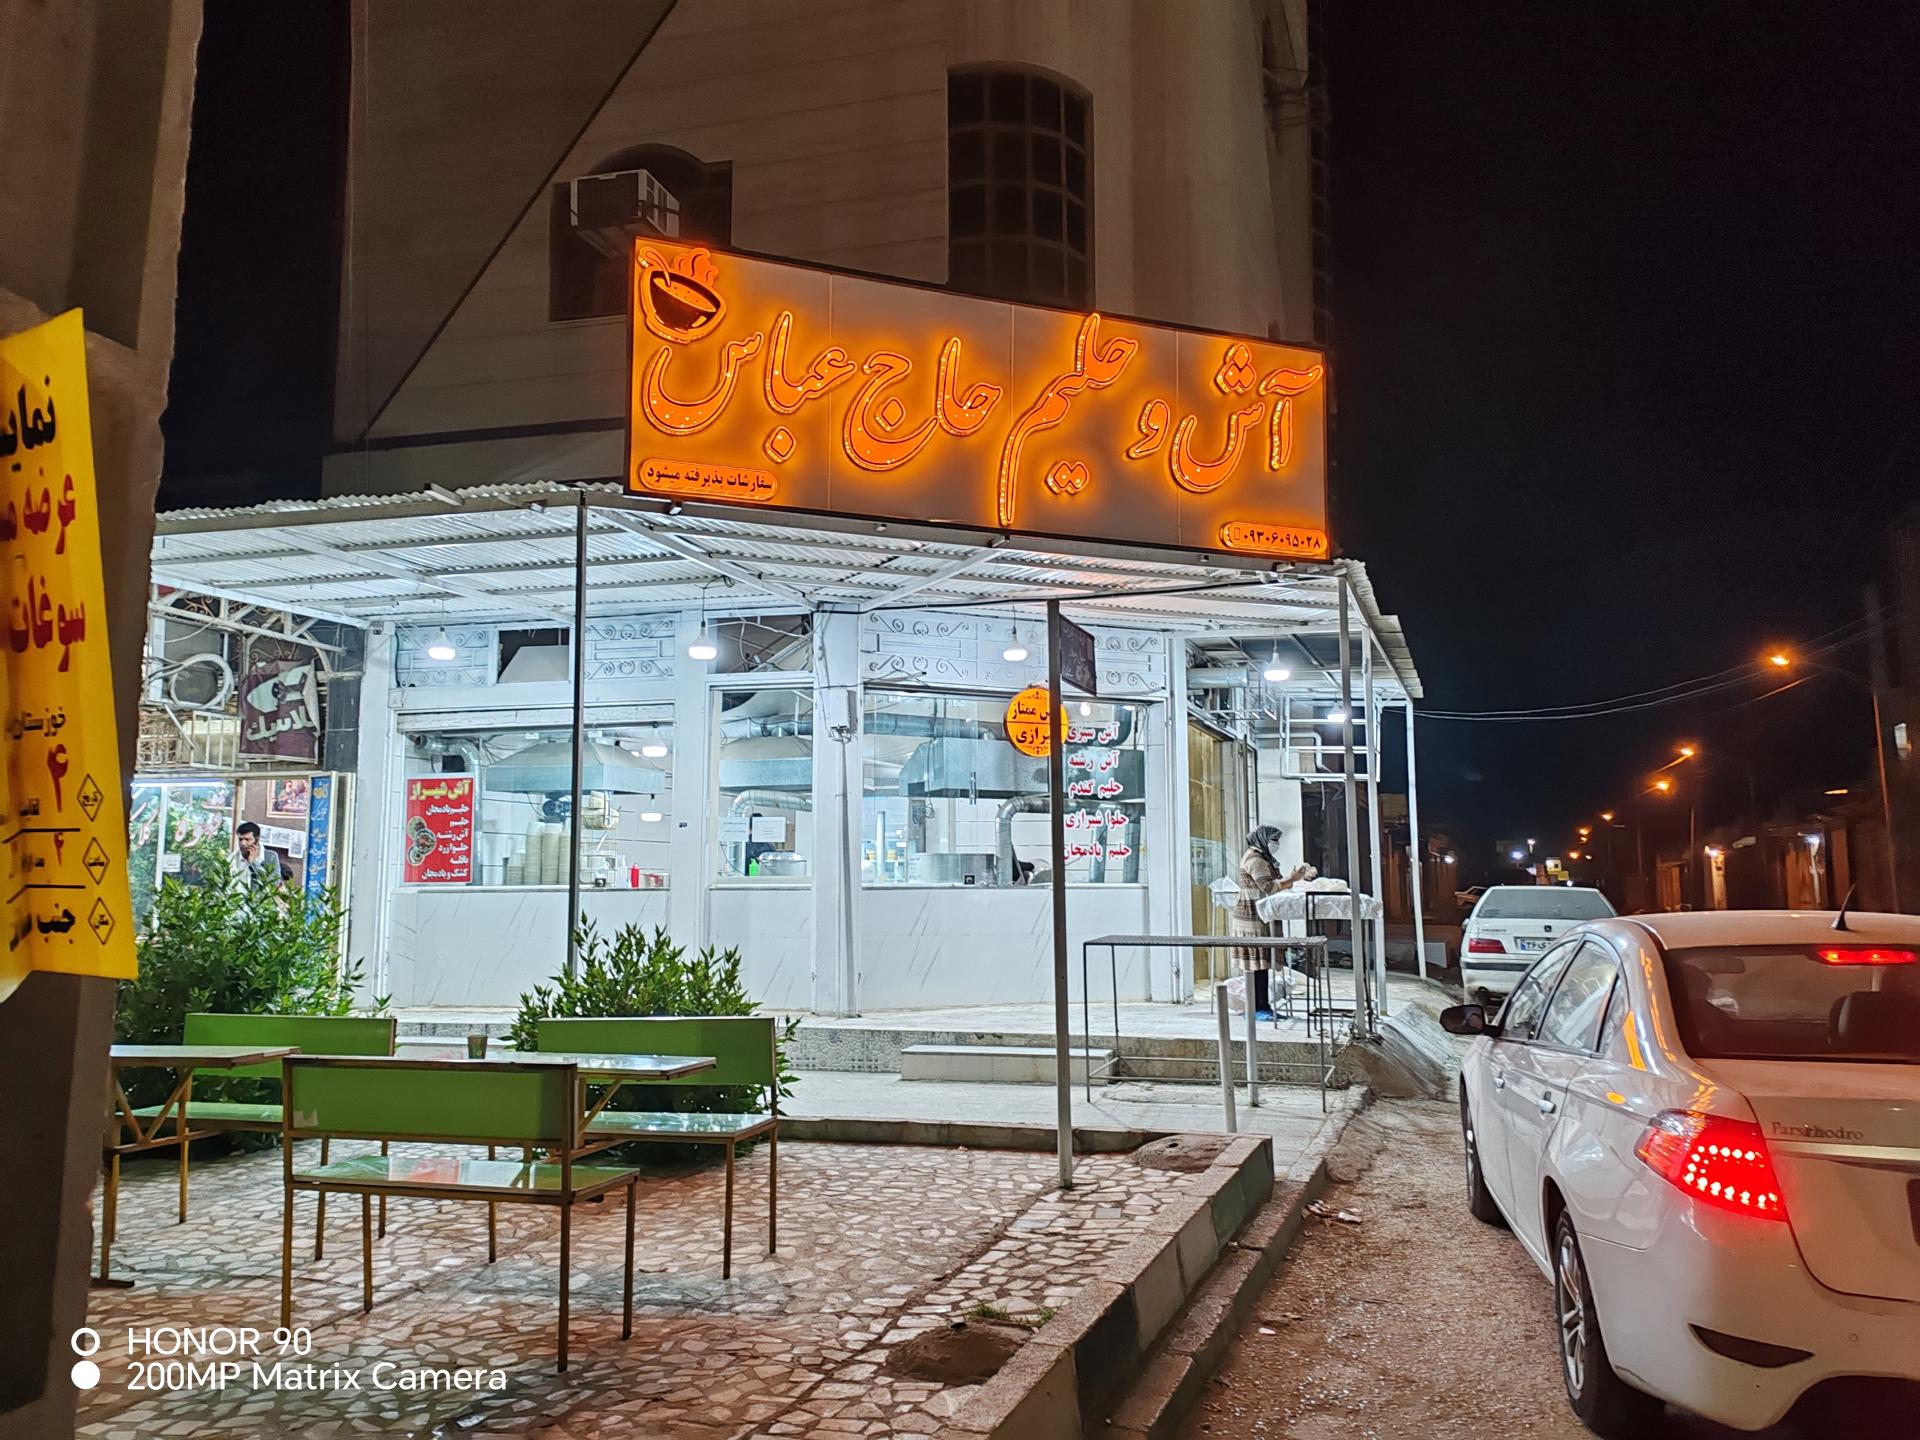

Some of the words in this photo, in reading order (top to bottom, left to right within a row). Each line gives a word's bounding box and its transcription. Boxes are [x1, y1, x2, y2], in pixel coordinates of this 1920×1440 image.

[641, 311, 856, 464] عباس
[844, 335, 1004, 472] حاج
[0, 375, 57, 471] نمای
[999, 312, 1138, 527] حلیم
[1129, 399, 1170, 459] و
[1171, 344, 1324, 494] آش
[726, 472, 773, 492] سفارشات
[1012, 699, 1037, 719] ممتاز
[1015, 725, 1051, 745] یرازی
[1098, 721, 1119, 743] آش
[1068, 753, 1094, 771] رشته
[1098, 749, 1119, 772] آش
[1098, 778, 1123, 798] حلیم
[1107, 841, 1131, 861] حلیم
